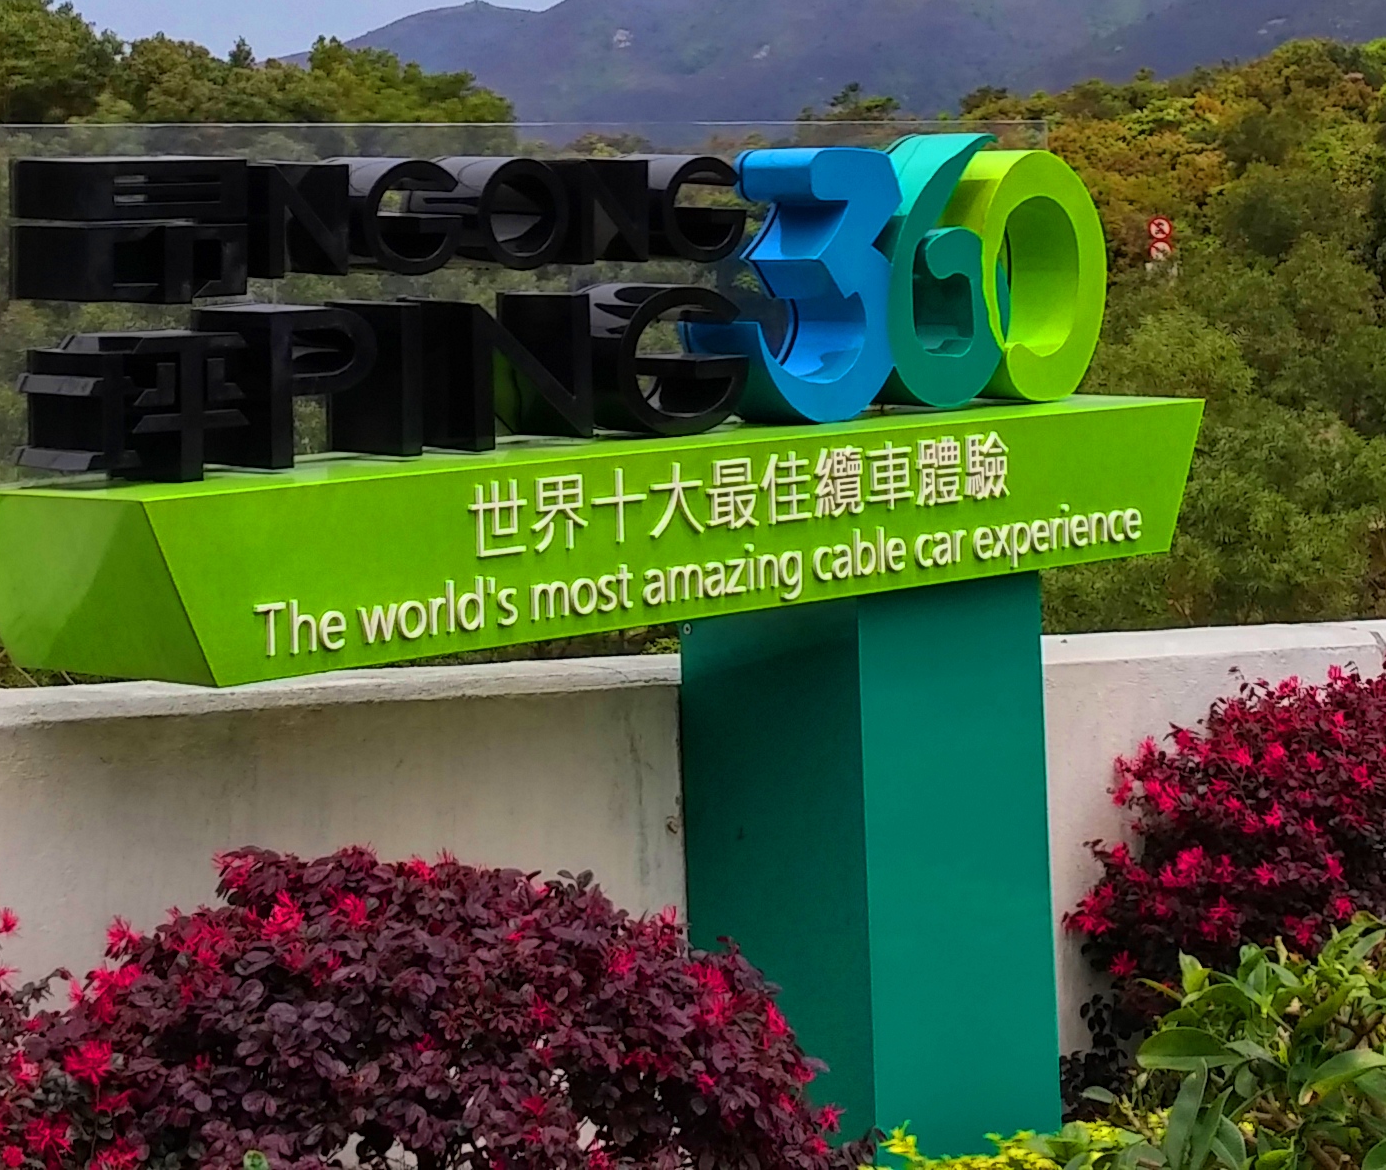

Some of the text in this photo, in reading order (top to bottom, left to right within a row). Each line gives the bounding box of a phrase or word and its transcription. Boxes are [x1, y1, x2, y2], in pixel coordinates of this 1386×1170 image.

[248, 154, 748, 279] NGONG
[678, 132, 1108, 424] 360
[223, 282, 751, 471] PING
[466, 430, 1011, 559] 世界十大最佳纜車體驗
[253, 503, 1142, 658] The world's most amazing cable car experience
